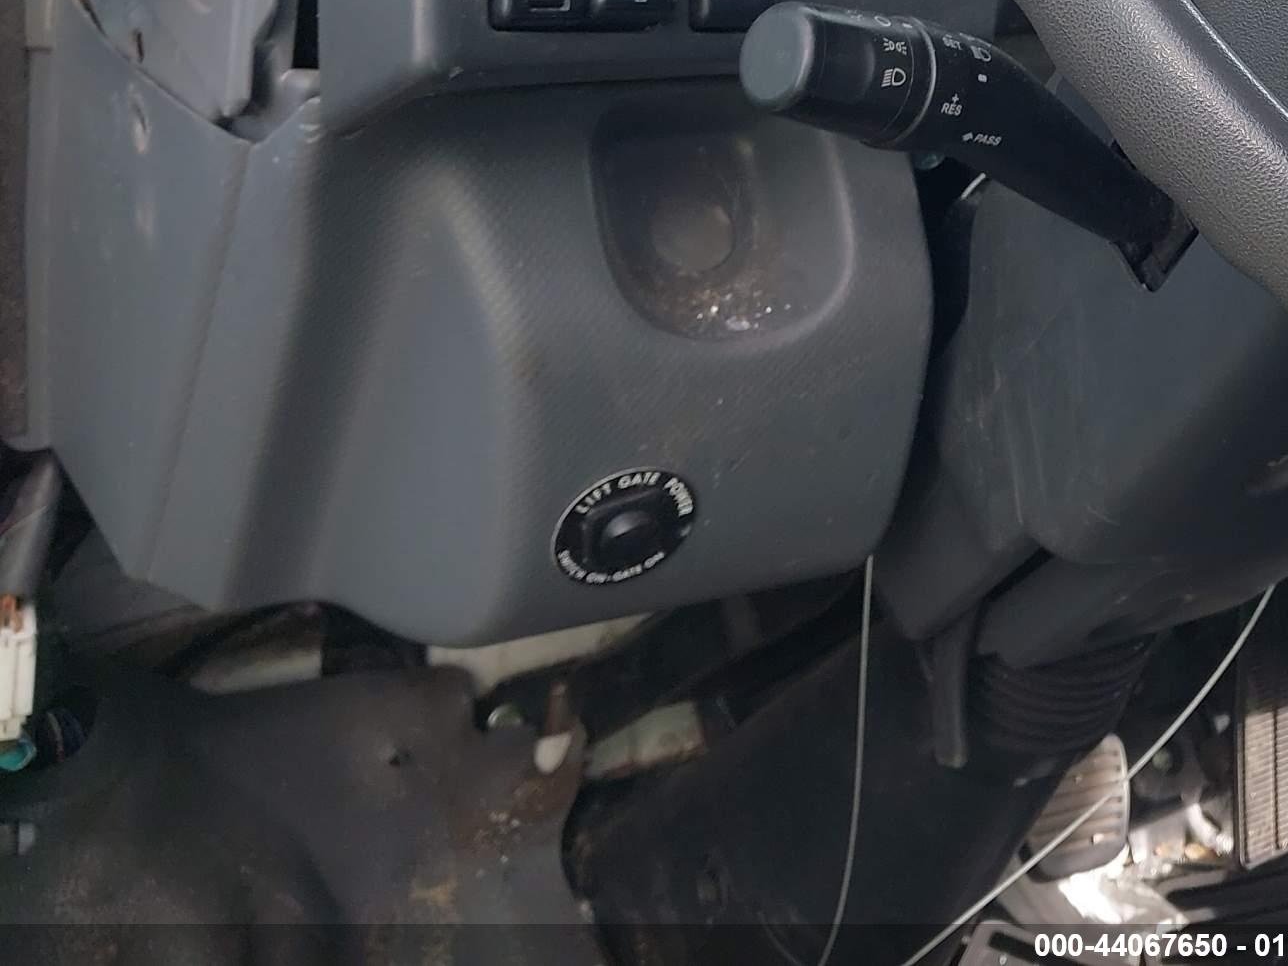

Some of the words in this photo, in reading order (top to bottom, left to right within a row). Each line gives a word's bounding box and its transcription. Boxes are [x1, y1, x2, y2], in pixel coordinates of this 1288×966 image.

[941, 103, 963, 116] RES
[974, 133, 1002, 146] PASS
[575, 483, 612, 515] LIFT
[617, 471, 661, 489] GATE
[663, 477, 695, 518] POWER
